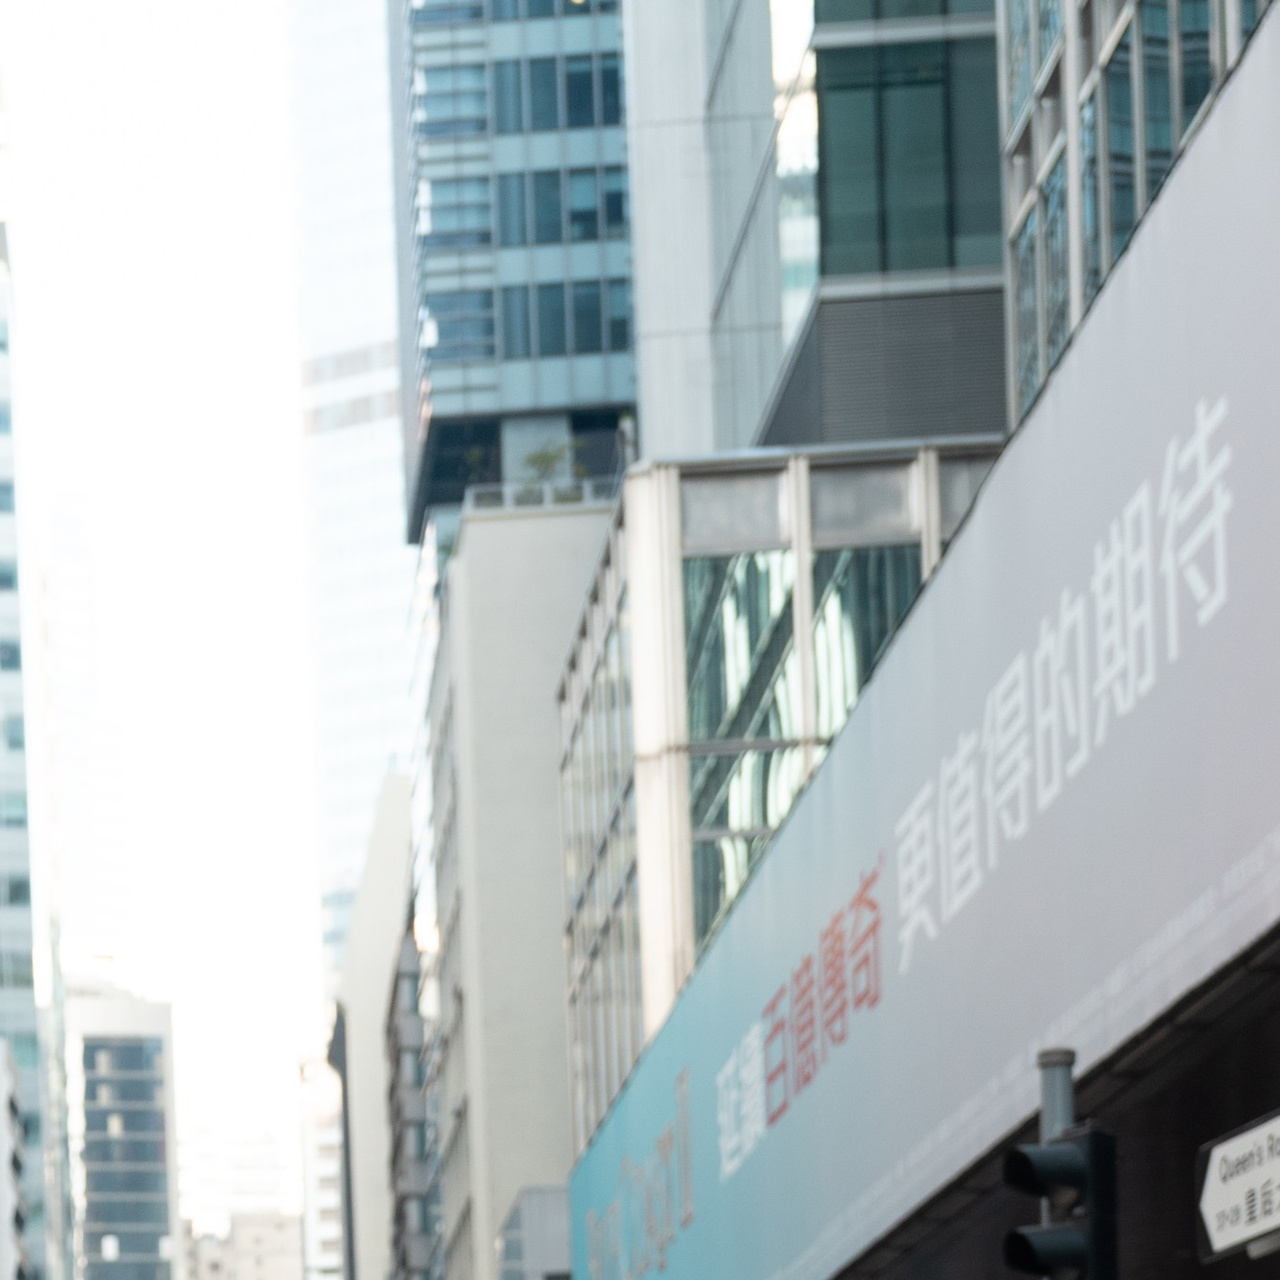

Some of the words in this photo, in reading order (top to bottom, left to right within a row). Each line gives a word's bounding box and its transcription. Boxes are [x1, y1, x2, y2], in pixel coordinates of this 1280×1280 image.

[895, 396, 1233, 976] 更值得的期待
[1219, 1141, 1263, 1184] Queen's
